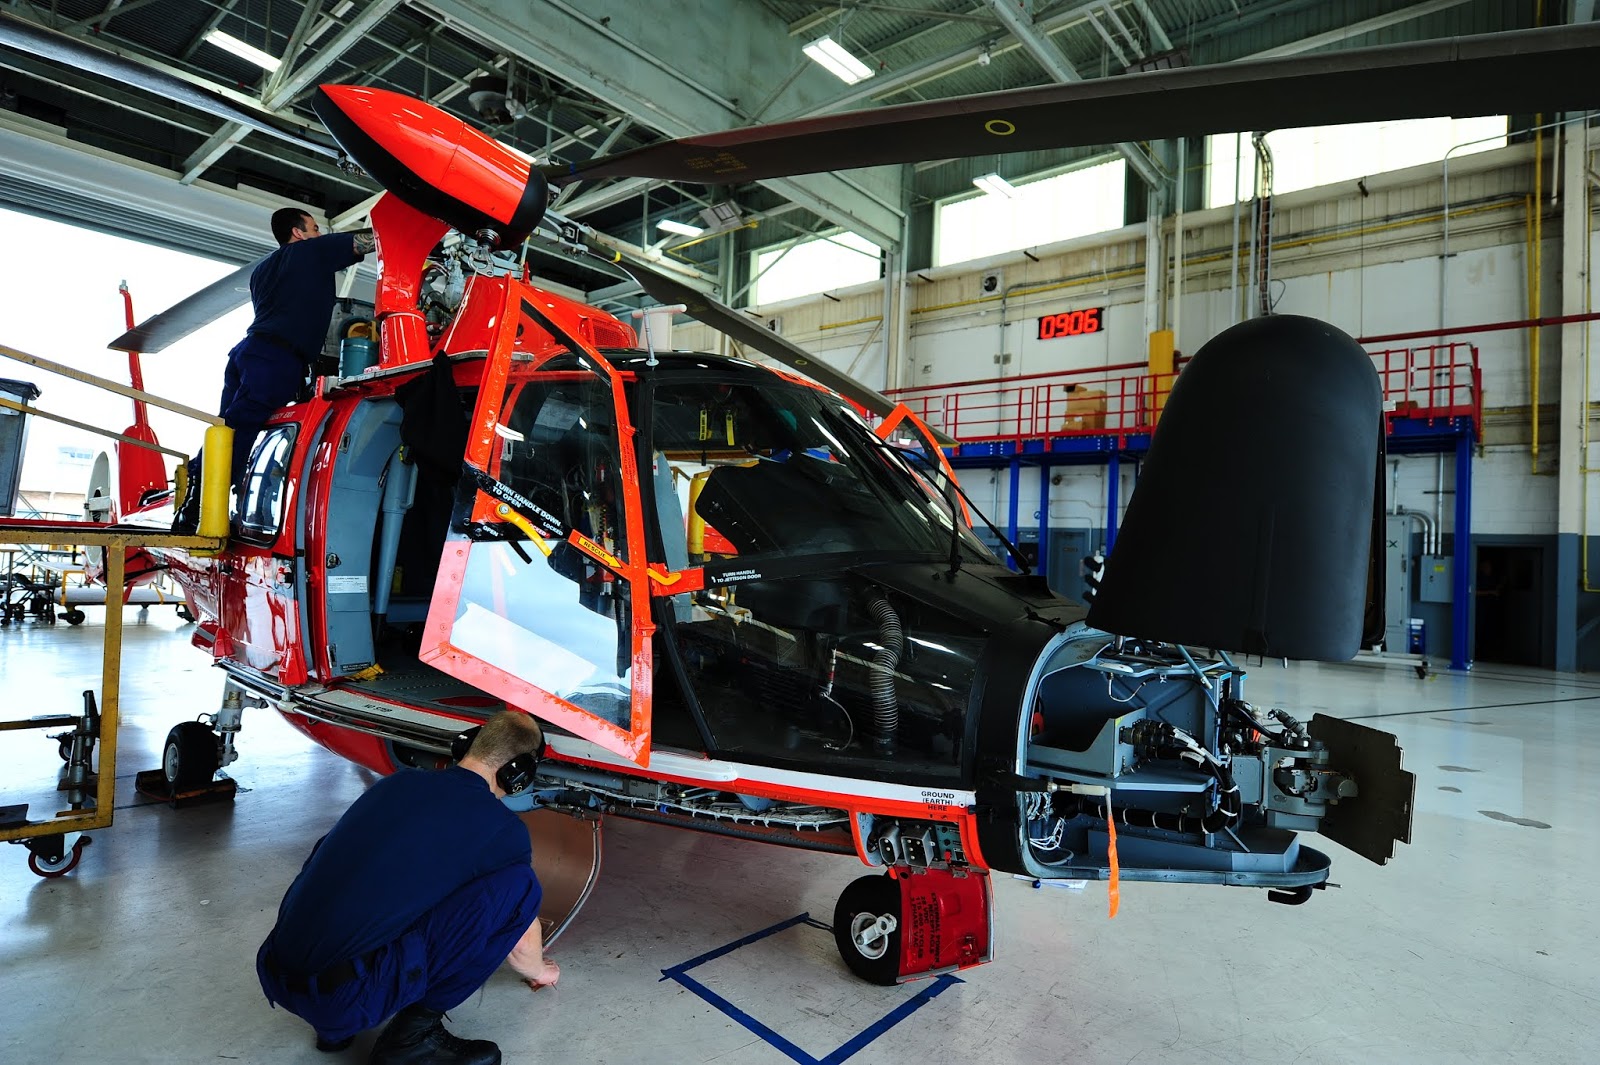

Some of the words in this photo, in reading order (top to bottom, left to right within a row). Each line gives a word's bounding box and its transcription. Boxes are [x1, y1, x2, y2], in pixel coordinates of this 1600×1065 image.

[1040, 307, 1100, 340] 0906
[492, 485, 503, 496] TO
[502, 493, 522, 508] OPEN
[495, 481, 514, 497] TURN
[514, 493, 541, 514] HANDLE
[540, 510, 562, 527] DOWN
[482, 525, 499, 537] OPEN
[542, 521, 564, 536] LOCKED
[583, 541, 606, 558] RESCUE
[921, 790, 955, 799] GROUND
[911, 903, 919, 929] PHASE
[931, 892, 940, 932] EXTERNAL
